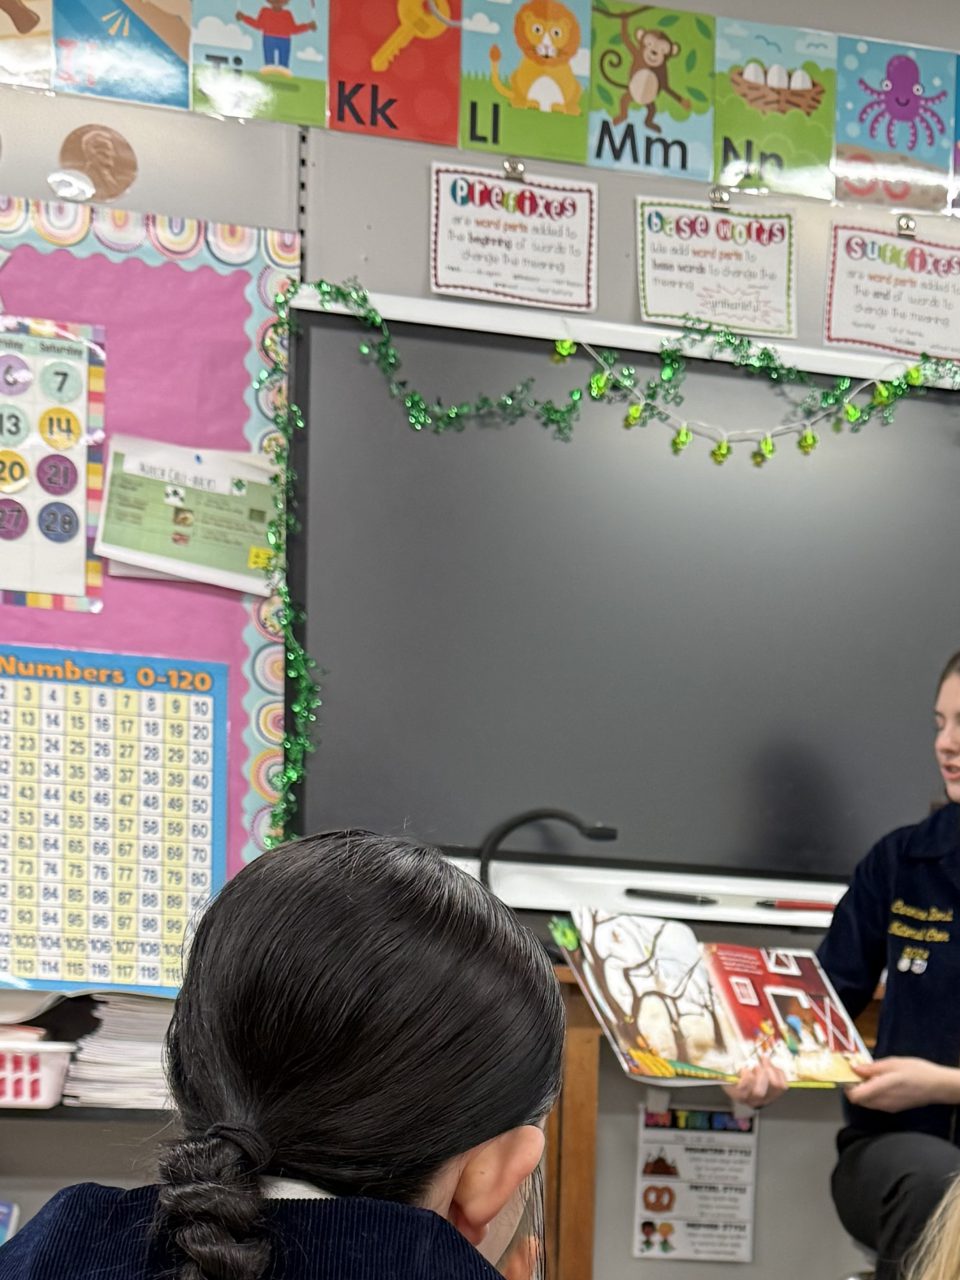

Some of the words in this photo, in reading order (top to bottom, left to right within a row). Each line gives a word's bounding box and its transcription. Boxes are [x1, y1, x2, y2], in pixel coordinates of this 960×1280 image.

[336, 80, 398, 130] Kk
[470, 101, 499, 144] Ll
[596, 120, 687, 170] Mm
[53, 371, 69, 393] 7
[48, 416, 73, 439] 14
[46, 464, 69, 486] 21
[45, 511, 73, 534] 28
[0, 655, 126, 684] Numbers
[136, 666, 213, 692] 0-120
